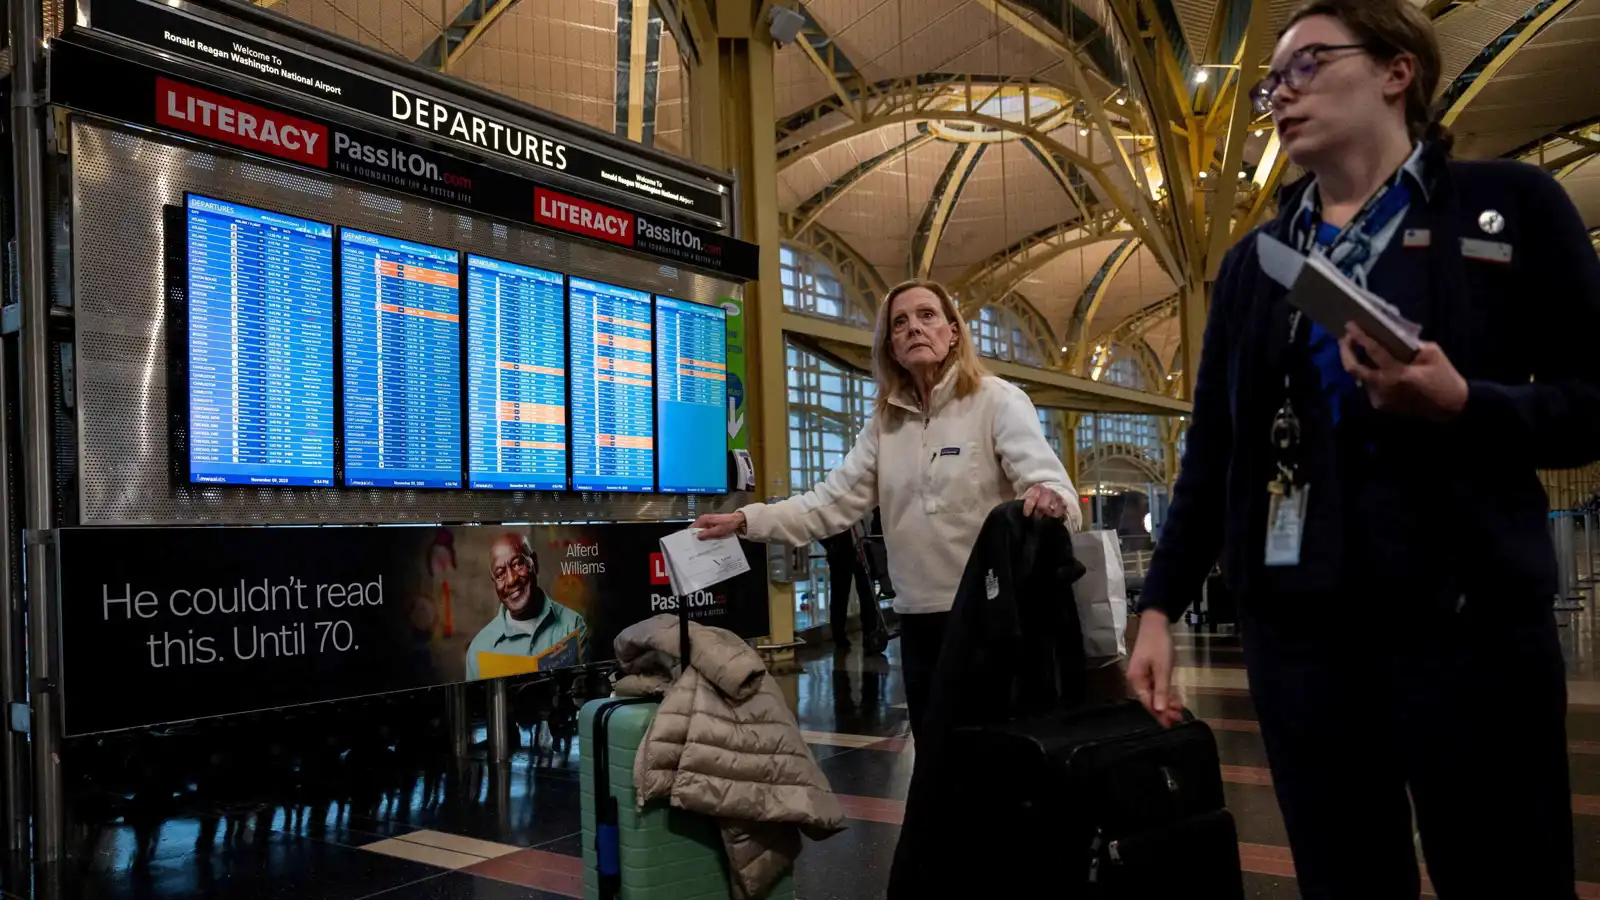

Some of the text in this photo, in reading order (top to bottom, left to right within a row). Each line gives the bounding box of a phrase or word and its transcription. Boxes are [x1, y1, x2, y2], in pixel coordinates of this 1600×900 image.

[164, 30, 342, 96] Ronald Reagan Washington National Airport
[233, 42, 282, 66] Welcome To
[168, 90, 319, 154] LITERACY
[392, 90, 567, 170] DEPARTURES
[334, 132, 472, 189] PassItOn.com
[336, 161, 350, 172] THE
[354, 166, 405, 186] FOUNDATION
[408, 180, 419, 189] FOR
[431, 186, 454, 198] BETTER
[458, 192, 472, 204] LIFE
[191, 199, 234, 214] DEPARTURES
[541, 196, 628, 237] LITERACY
[560, 561, 606, 576] Williams
[566, 543, 599, 557] Alferd
[102, 574, 383, 620] He couldn't read
[146, 620, 359, 668] this. Until 70.
